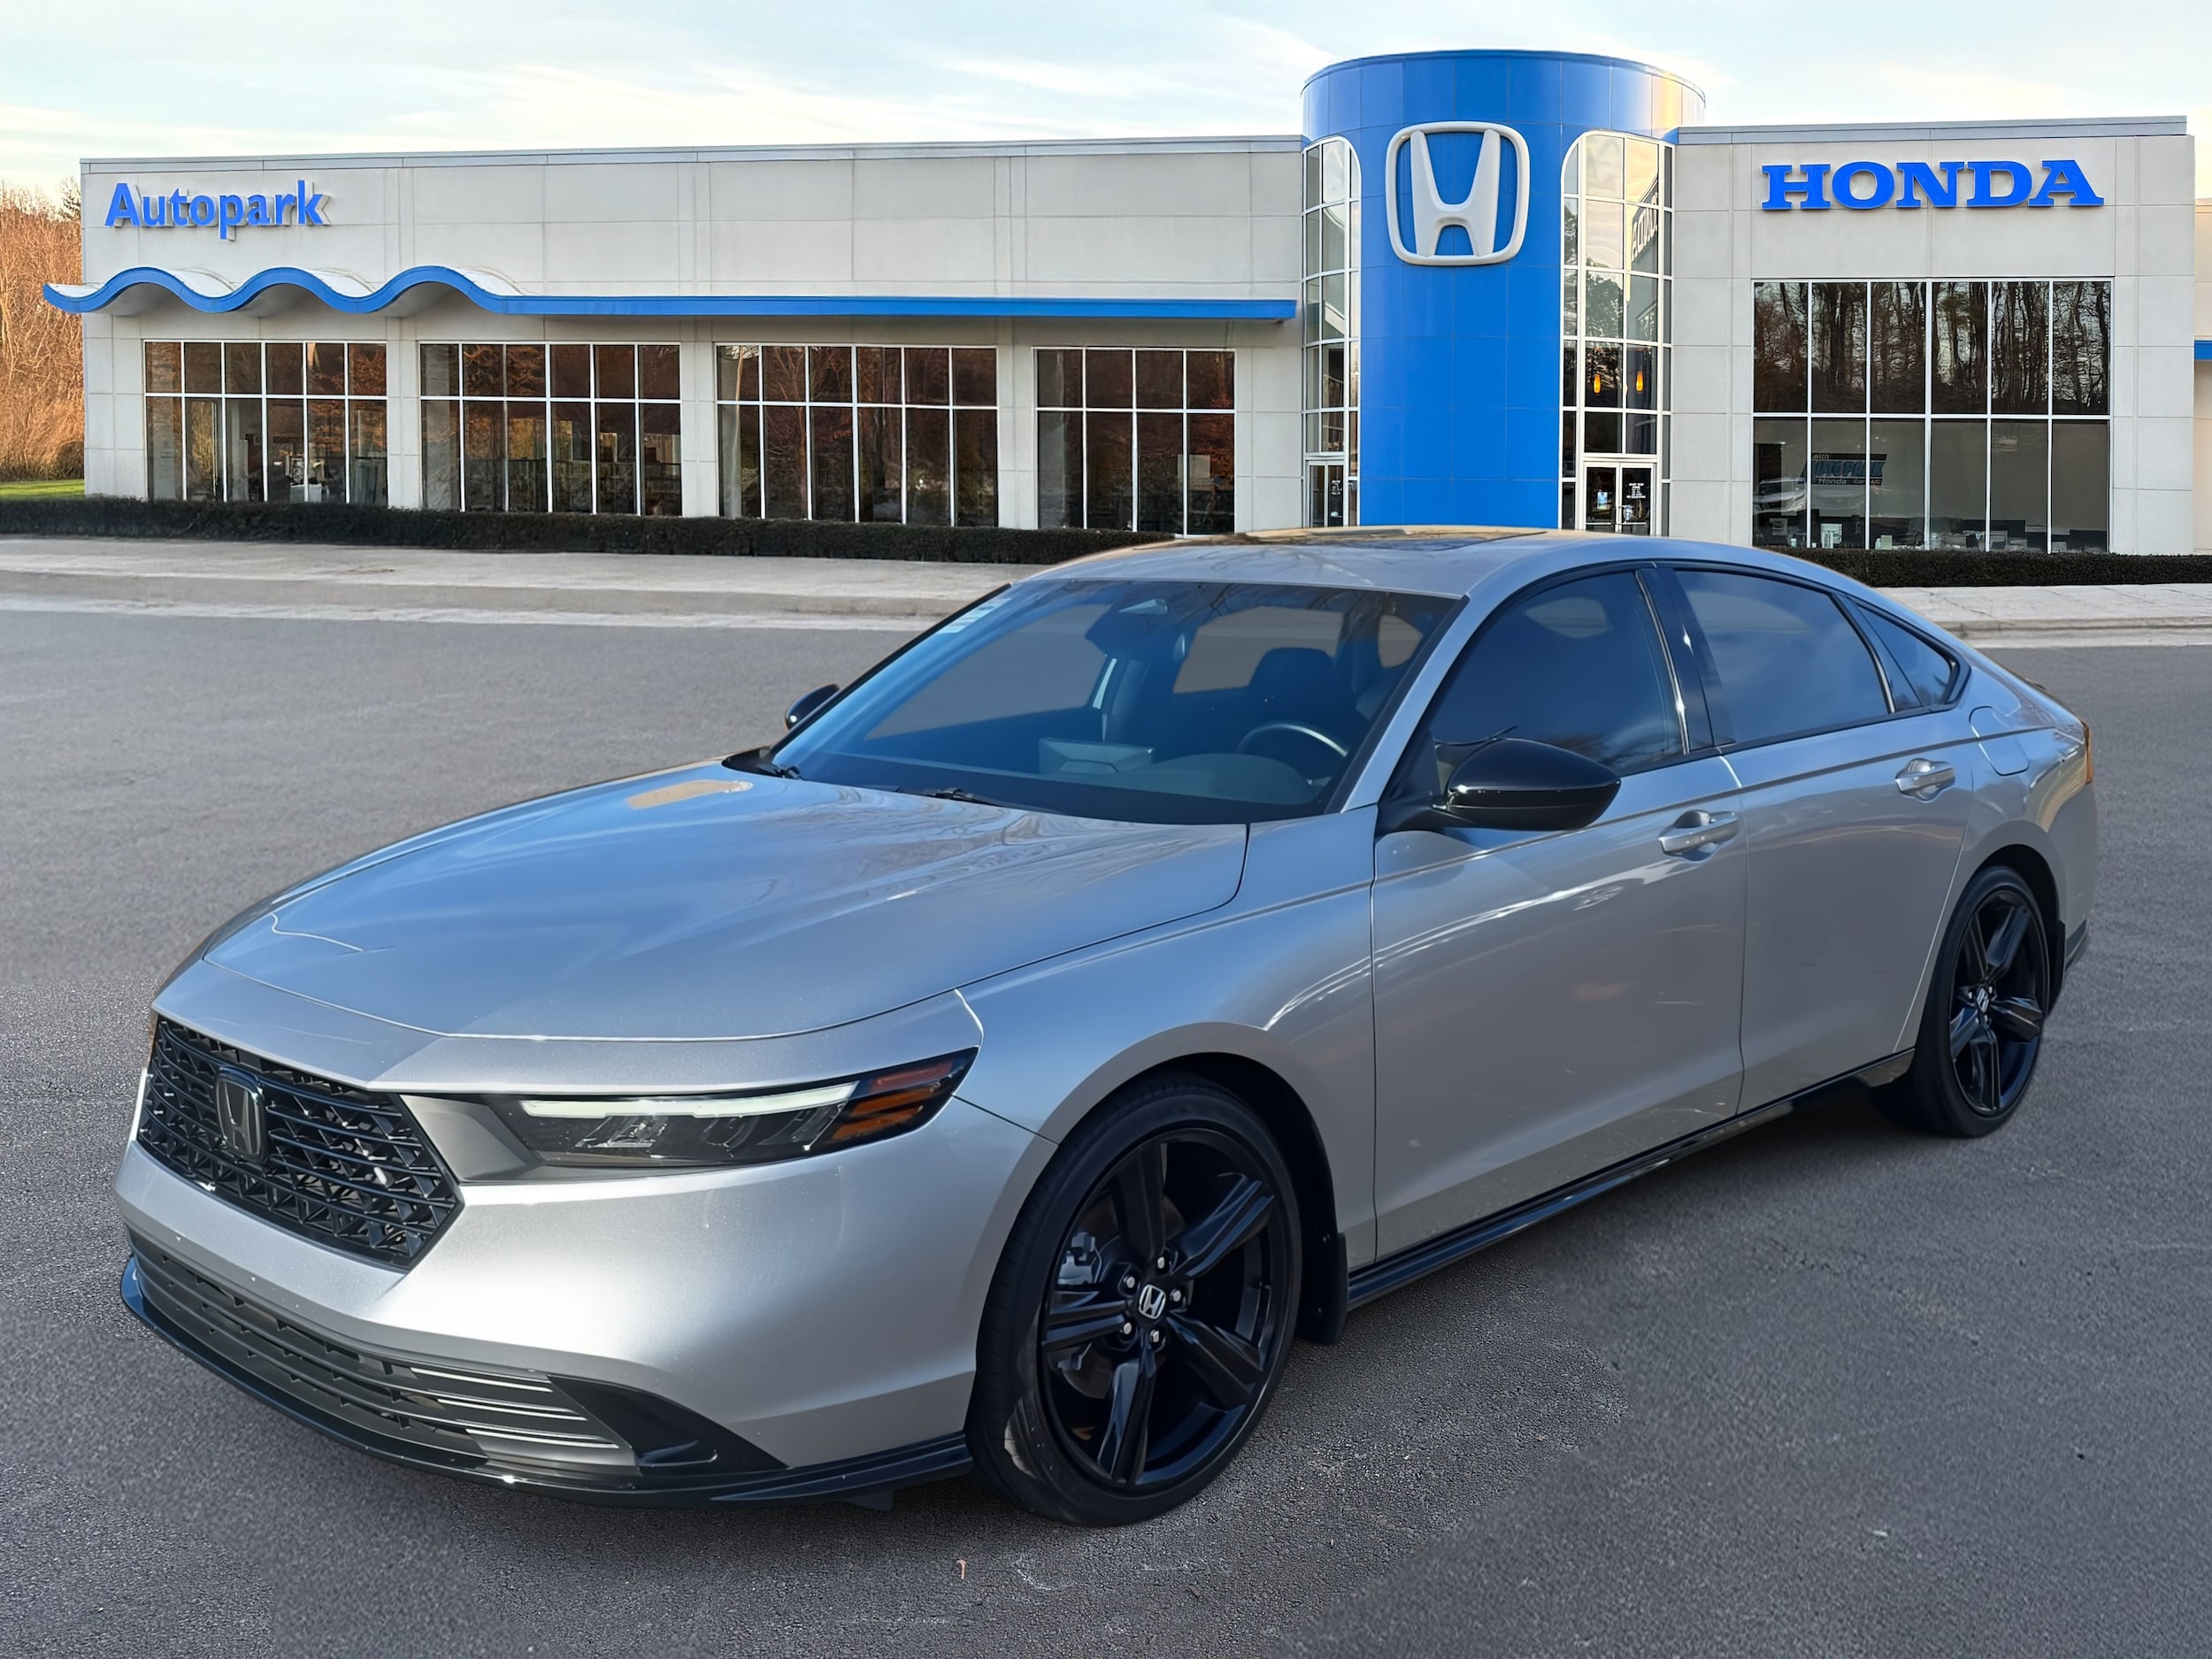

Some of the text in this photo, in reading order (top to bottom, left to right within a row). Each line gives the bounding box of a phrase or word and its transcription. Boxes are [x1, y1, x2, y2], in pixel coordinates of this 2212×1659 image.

[104, 180, 328, 240] Autopark
[1762, 159, 2105, 210] HONDA
[1801, 460, 1886, 478] UTOPAK
